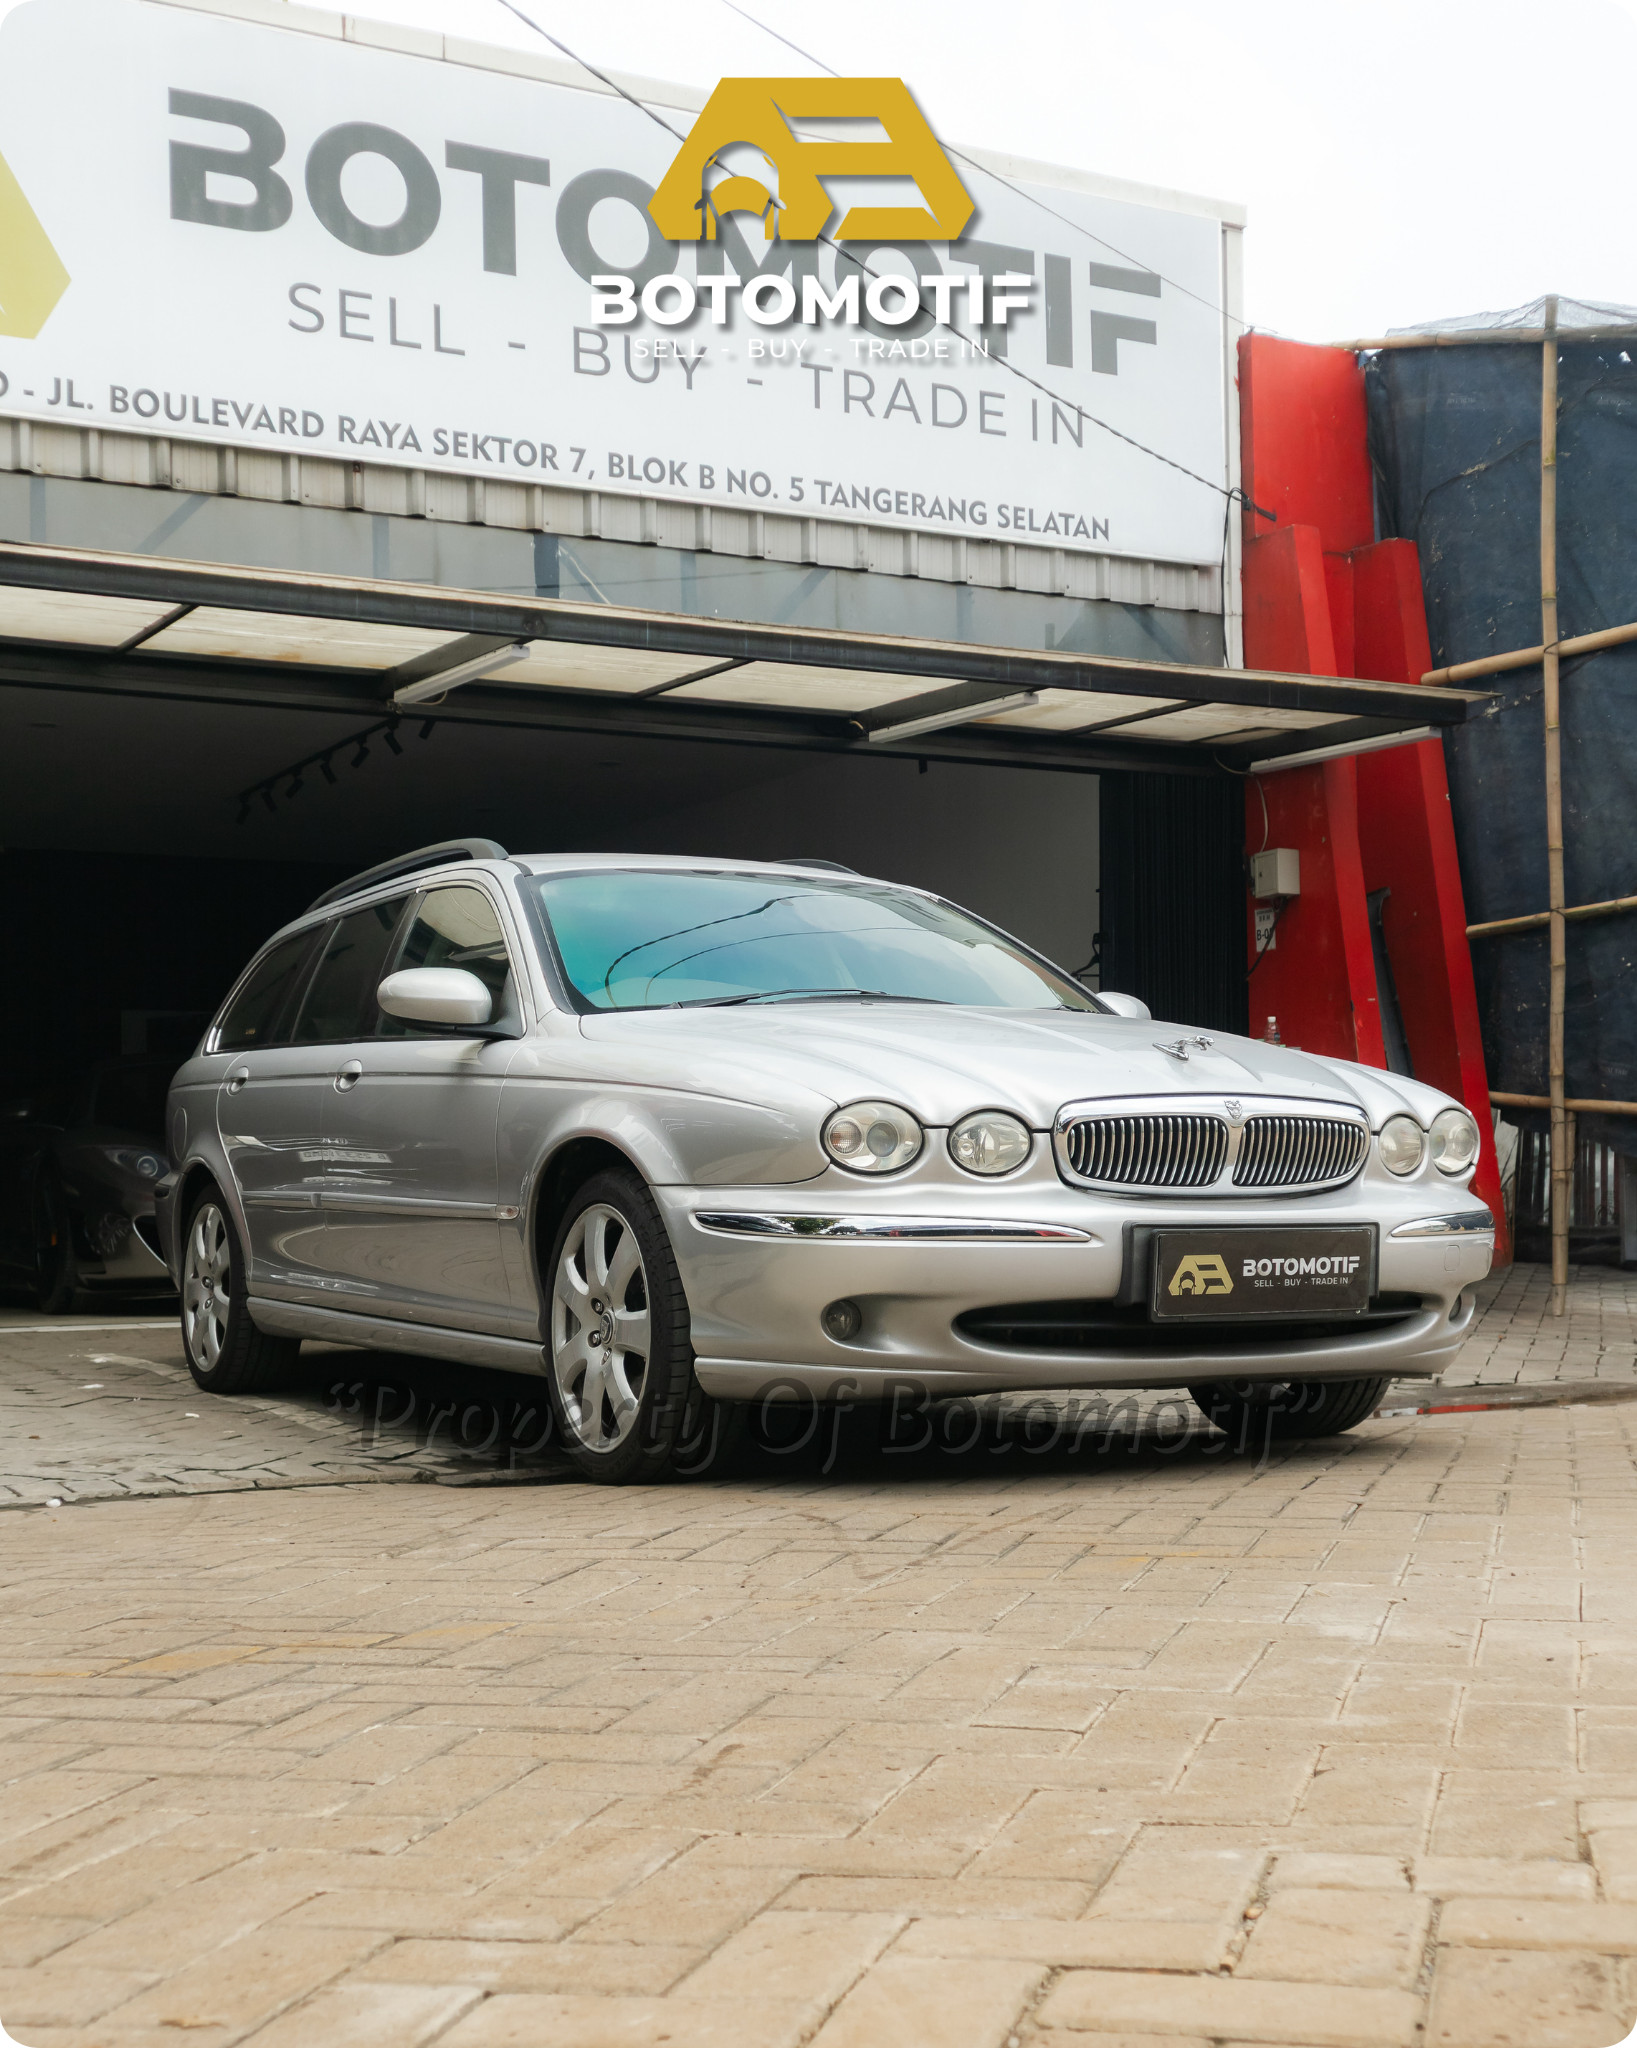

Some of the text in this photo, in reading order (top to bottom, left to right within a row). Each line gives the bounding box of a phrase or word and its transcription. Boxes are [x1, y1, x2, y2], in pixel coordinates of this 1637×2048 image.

[288, 281, 466, 357] SELL
[573, 326, 708, 391] BUY
[800, 361, 1007, 437] TRADE
[1031, 397, 1084, 449] IN
[46, 376, 94, 411] JL.
[109, 384, 325, 438] BOULEVARD
[337, 414, 423, 453] RAYA
[432, 427, 560, 471] SEKTOR
[568, 446, 596, 481] 7,
[607, 451, 689, 488] BLOK
[699, 463, 716, 490] B
[726, 467, 779, 499] NO.
[788, 476, 805, 502] 5
[813, 479, 988, 526] TANGERANG
[996, 503, 1110, 542] SELATAN
[1242, 1256, 1360, 1277] BOTOMOTIF
[1254, 1279, 1275, 1288] SELL
[1284, 1278, 1302, 1287] BUY
[1311, 1277, 1338, 1286] TRADE
[1339, 1276, 1349, 1285] IN
